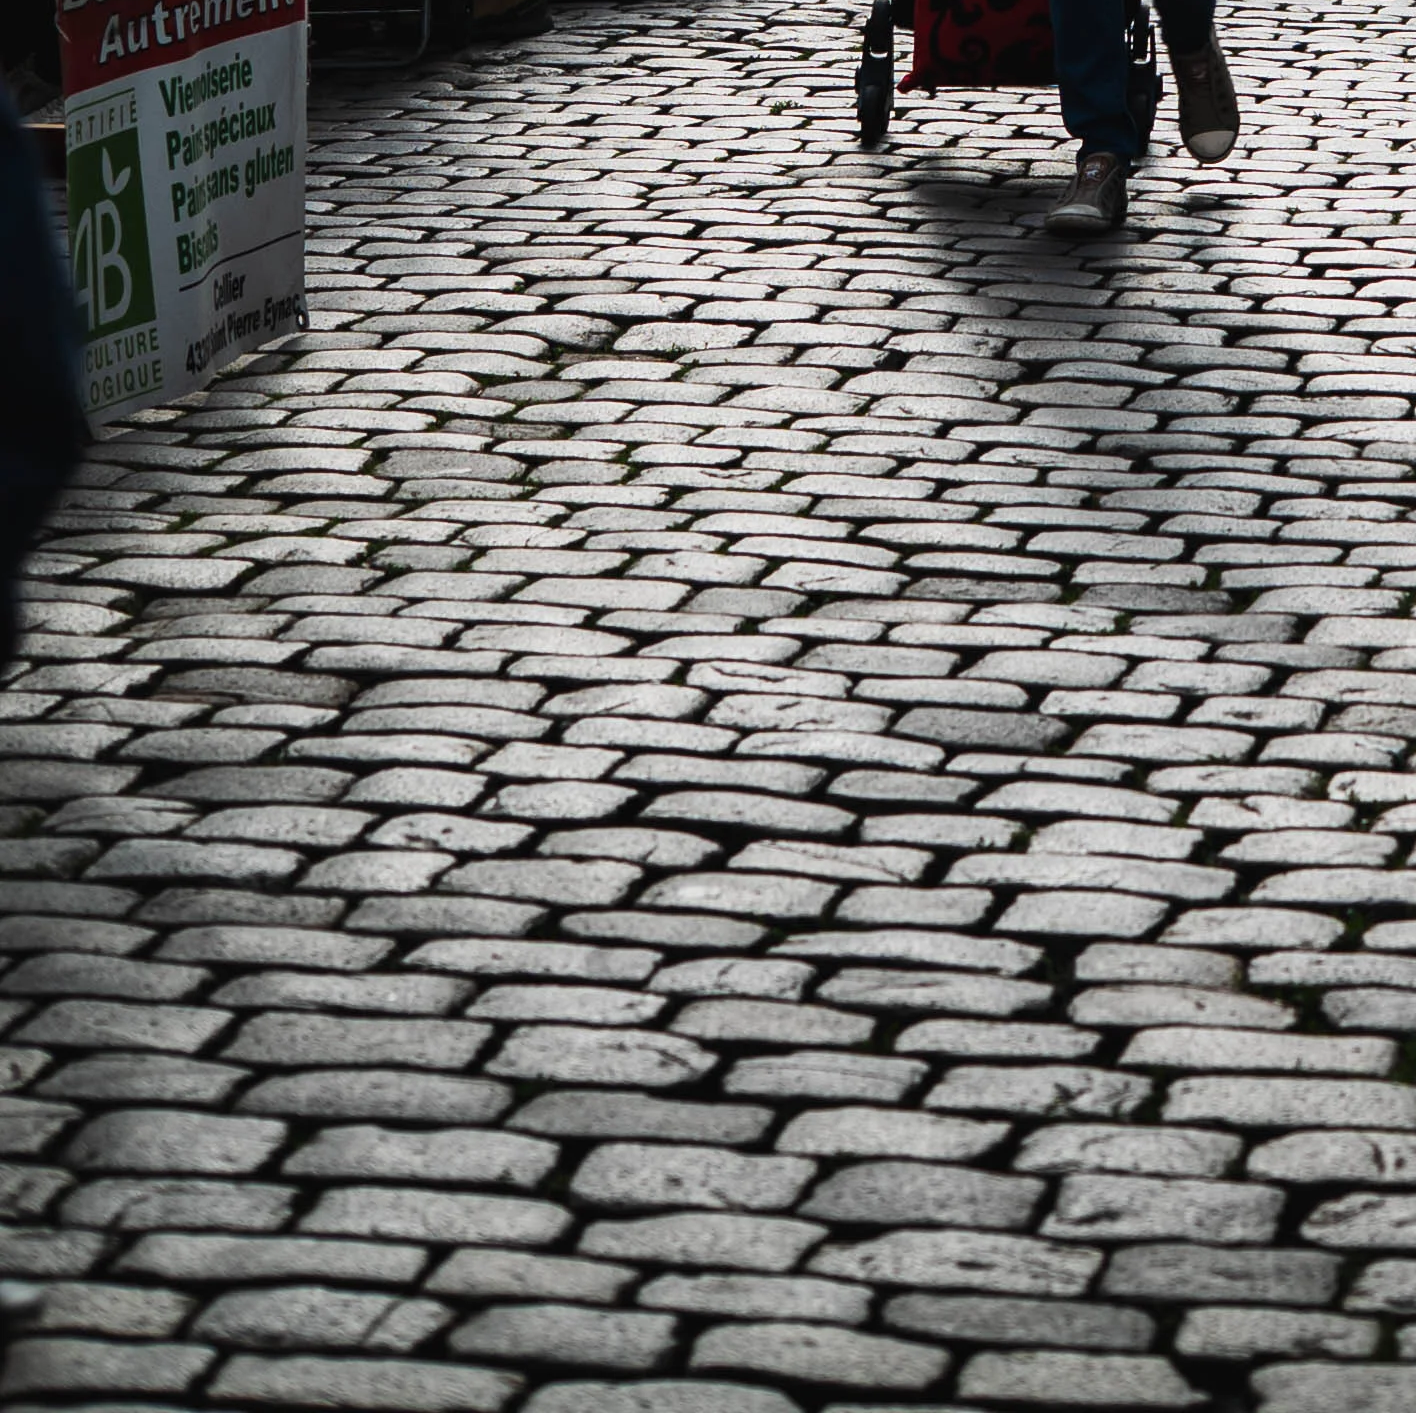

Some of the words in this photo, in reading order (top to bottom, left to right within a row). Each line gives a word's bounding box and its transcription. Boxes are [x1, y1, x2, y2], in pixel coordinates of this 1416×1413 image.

[68, 93, 138, 149] ERTIFIÉ
[204, 102, 276, 159] spéciaux
[206, 163, 239, 204] sans
[245, 143, 294, 198] gluten
[73, 198, 133, 332] AB
[227, 309, 261, 344] Pierre
[263, 292, 300, 332] Eynac
